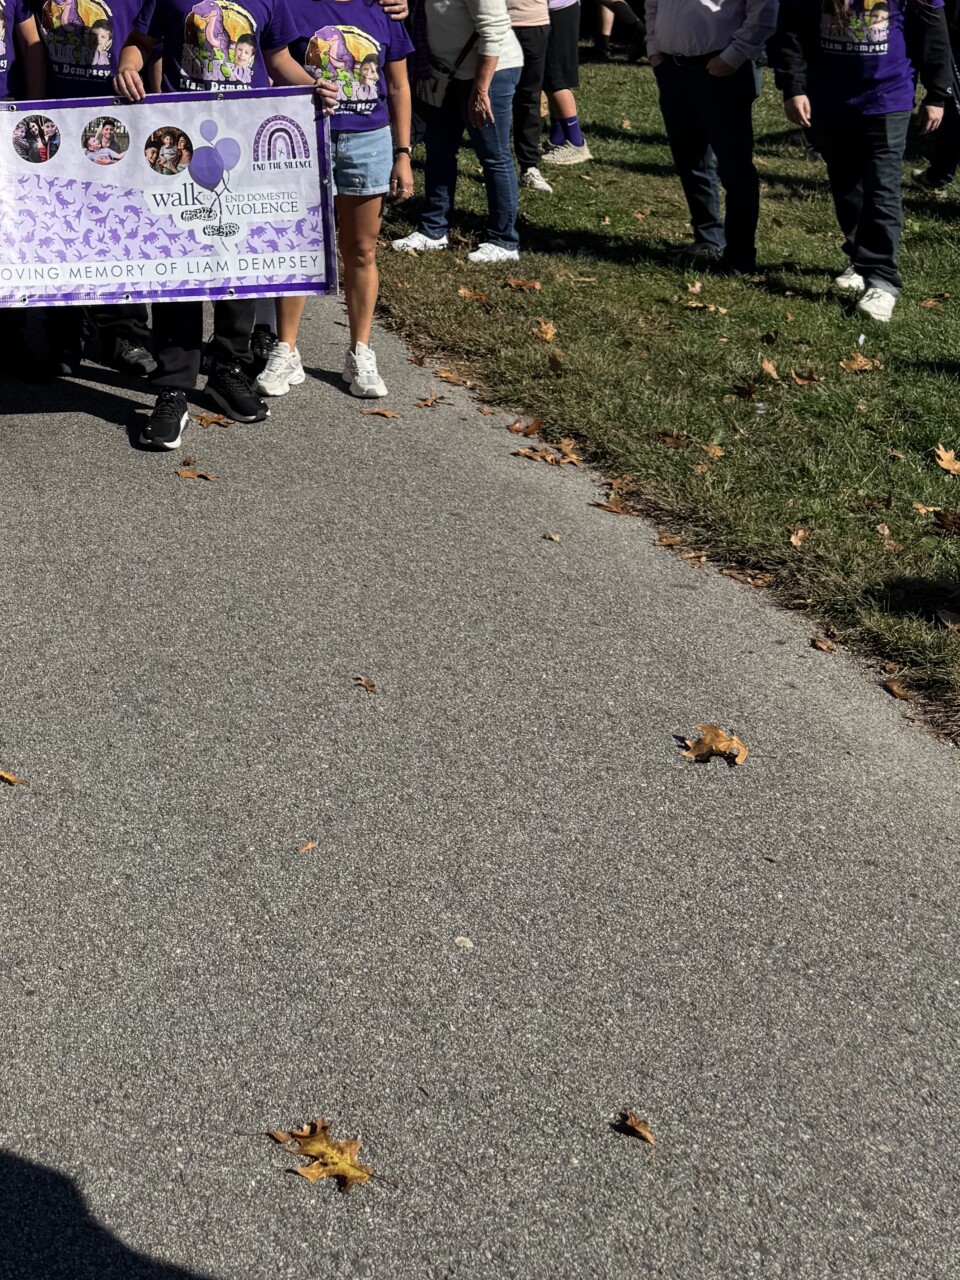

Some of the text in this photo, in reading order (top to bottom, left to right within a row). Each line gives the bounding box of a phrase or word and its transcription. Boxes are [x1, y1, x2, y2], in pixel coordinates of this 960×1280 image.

[48, 42, 77, 65] ALK
[821, 40, 889, 53] Liam Dempsey
[62, 64, 111, 79] Dempsey
[180, 59, 225, 81] WALK
[179, 78, 206, 91] Liam
[252, 160, 313, 171] END THE SILENCE
[151, 183, 204, 207] walk
[225, 195, 245, 203] END
[247, 191, 298, 202] DOMESTIC
[225, 202, 299, 216] VIOLENCE
[69, 264, 145, 279] MEMORY
[155, 262, 178, 276] OF
[187, 260, 229, 274] LIAM
[238, 255, 319, 271] DEMPSEY
